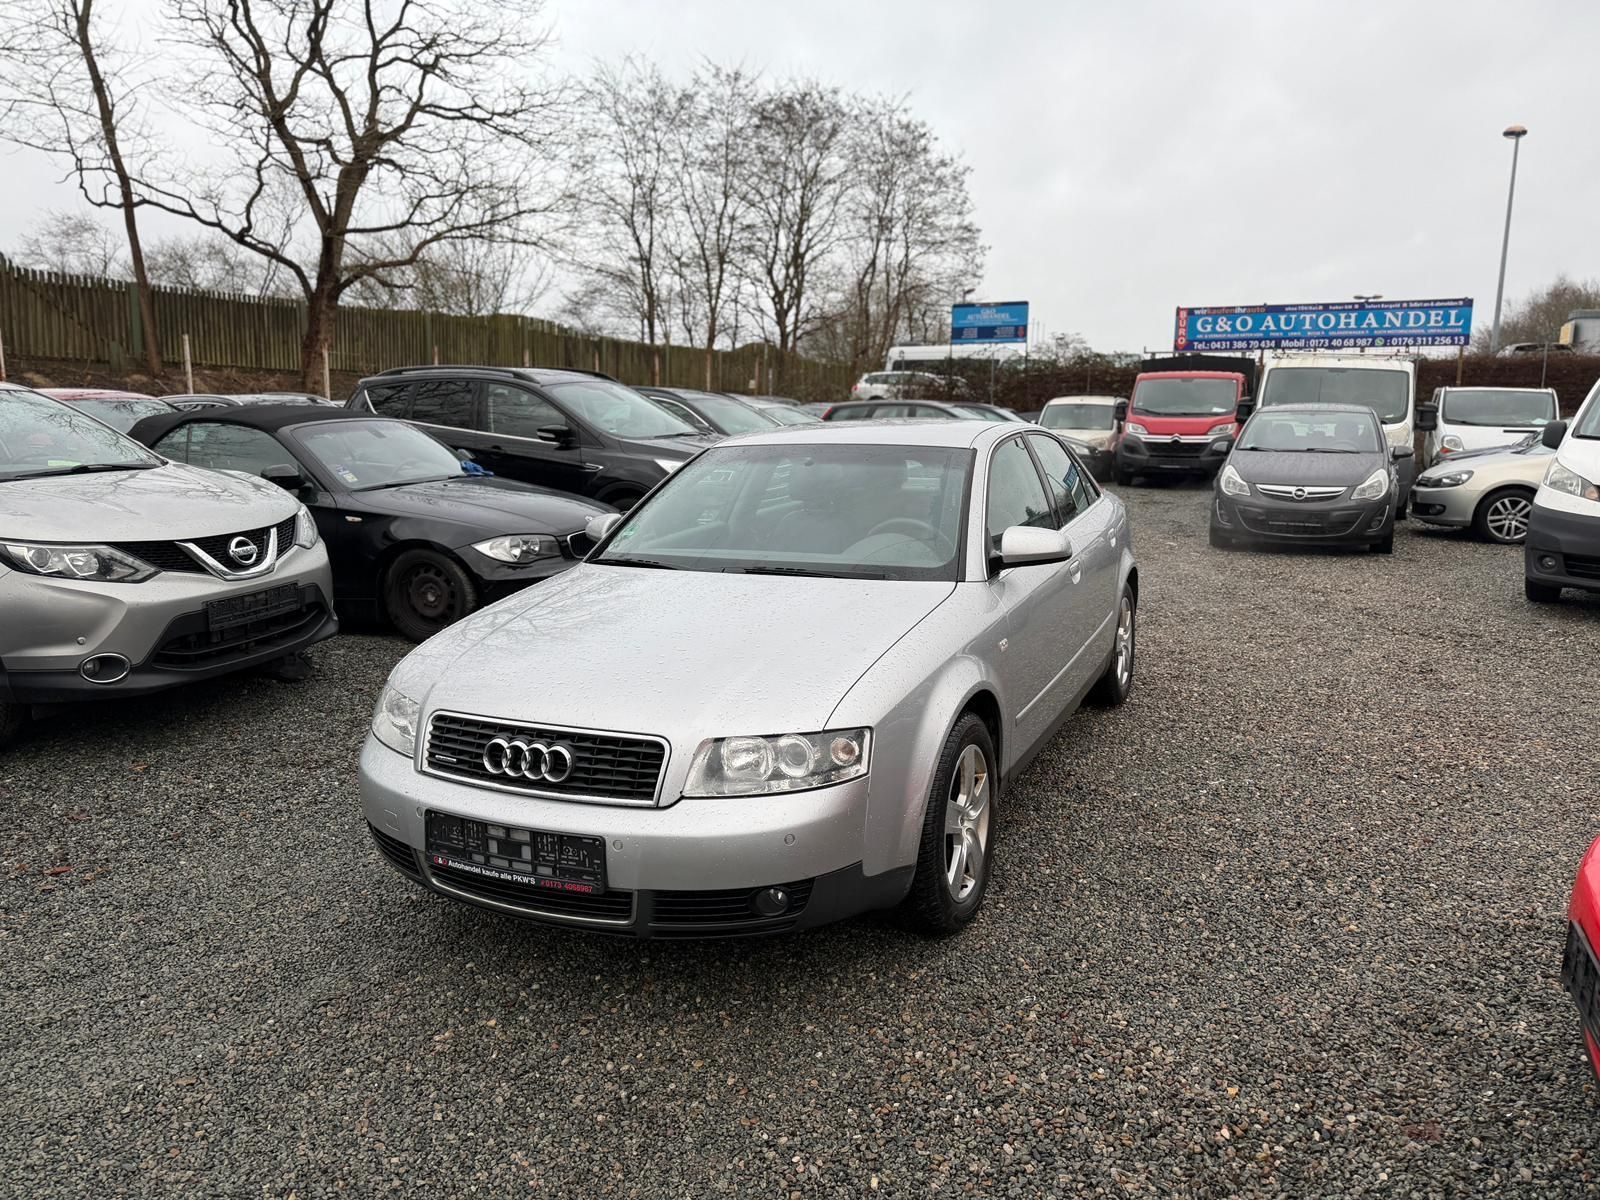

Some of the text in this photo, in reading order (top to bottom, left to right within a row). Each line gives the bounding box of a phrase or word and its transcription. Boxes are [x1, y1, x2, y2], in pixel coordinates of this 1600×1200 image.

[1196, 309, 1464, 333] G&O AUTOHANDEL
[1193, 342, 1210, 350] Tel.:
[1211, 341, 1230, 349] 0431
[1232, 340, 1247, 348] 386
[1249, 340, 1259, 348] 70
[1260, 340, 1275, 348] 434
[1331, 338, 1342, 346] 40
[1343, 338, 1354, 346] 68
[1356, 338, 1372, 346] 987
[1391, 337, 1414, 346] 0176
[1416, 337, 1432, 345] 311
[1434, 336, 1451, 345] 256
[1454, 336, 1465, 344] 13
[448, 857, 481, 874] Autohandel
[482, 867, 499, 878] kaufe
[500, 871, 512, 881] alle
